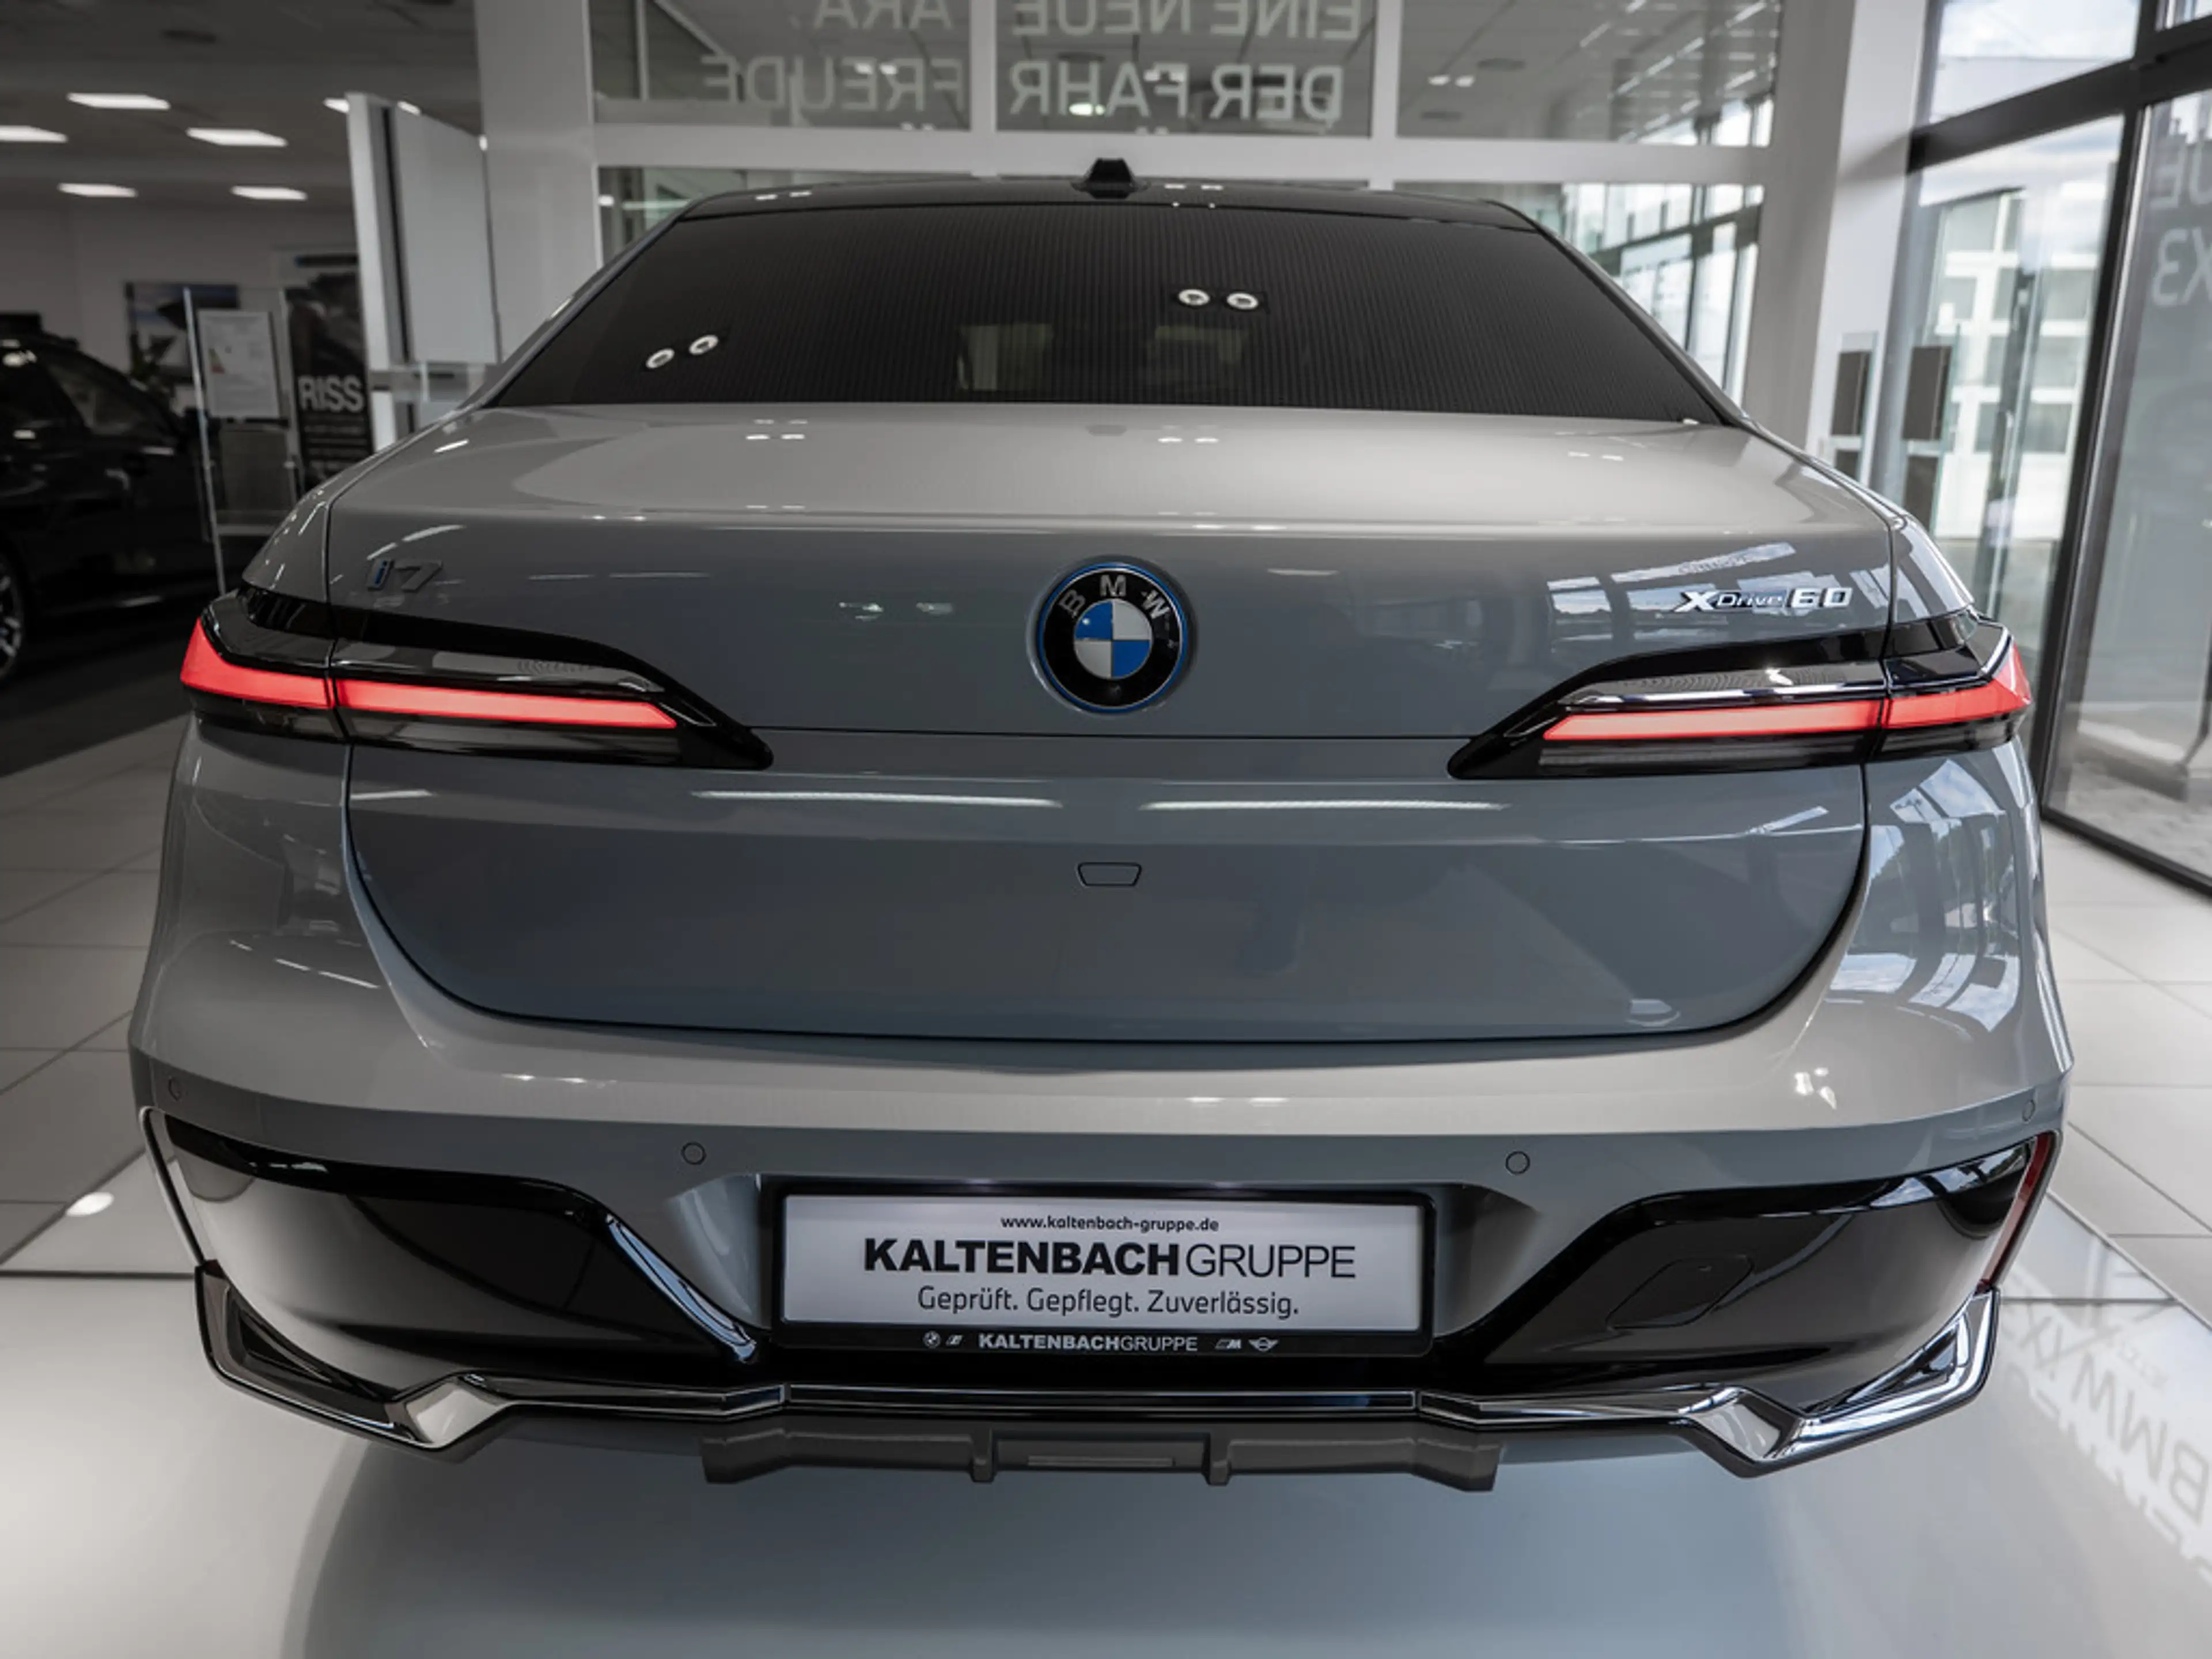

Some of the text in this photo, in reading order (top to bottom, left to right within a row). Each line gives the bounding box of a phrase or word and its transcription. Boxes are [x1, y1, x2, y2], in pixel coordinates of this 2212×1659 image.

[1058, 574, 1171, 620] BMW
[1000, 1214, 1220, 1234] www.kaltenbach-gruppe.de
[918, 1285, 1300, 1321] Geprüft. Gepflegt. Zuverlässig.
